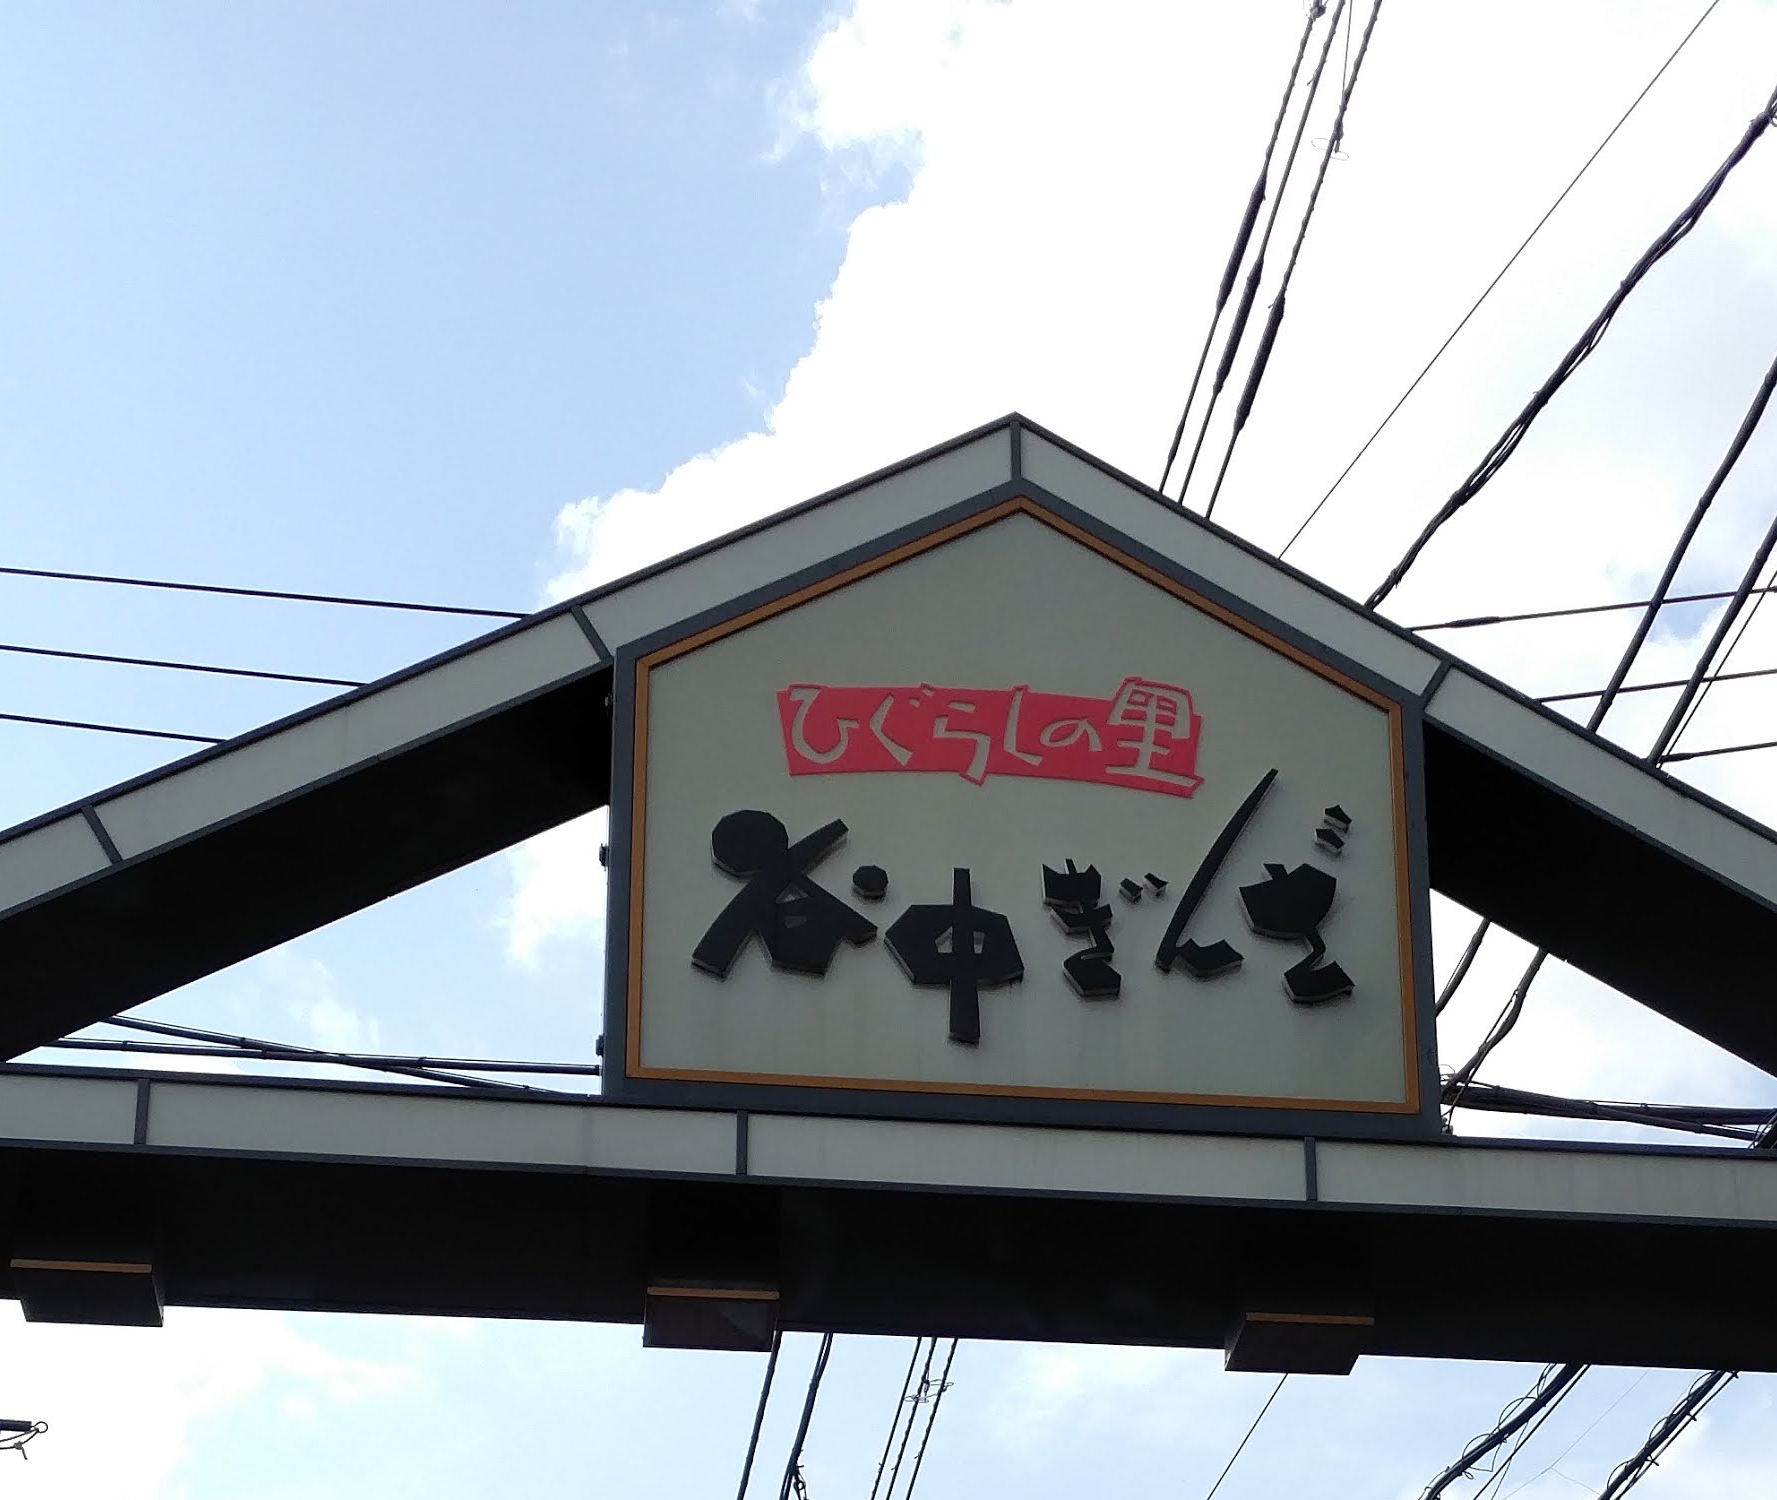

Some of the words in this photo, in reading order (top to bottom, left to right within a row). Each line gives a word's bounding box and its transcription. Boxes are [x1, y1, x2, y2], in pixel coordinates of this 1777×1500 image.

[786, 676, 1203, 797] ひぐらしの里
[691, 768, 1354, 1045] 谷中ぎんざ
